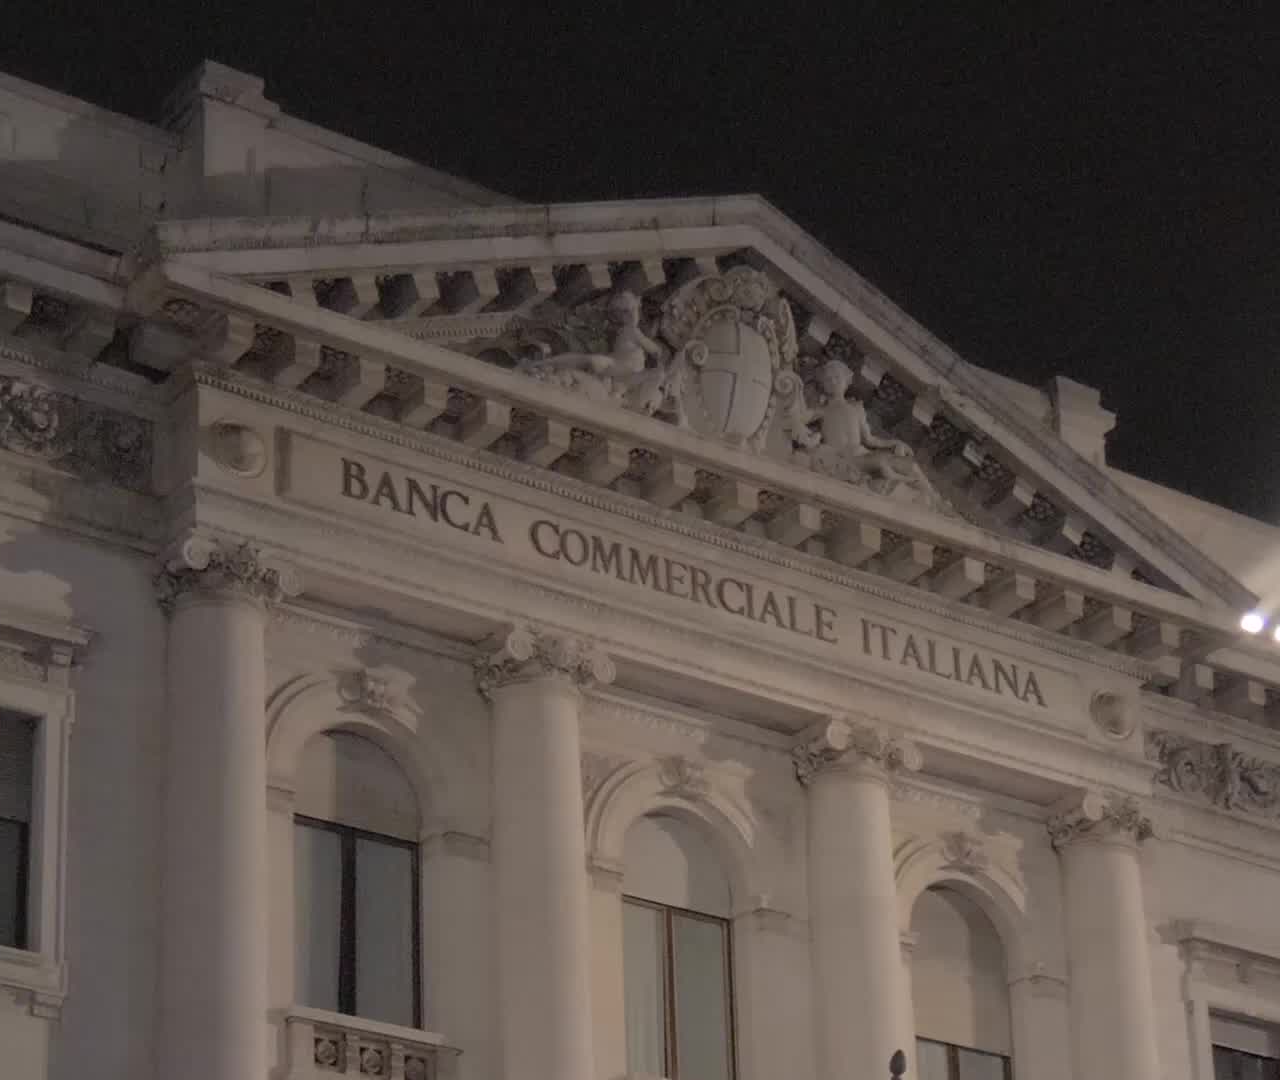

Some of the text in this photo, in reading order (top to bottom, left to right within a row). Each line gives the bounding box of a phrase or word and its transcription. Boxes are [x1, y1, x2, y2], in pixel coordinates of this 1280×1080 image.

[341, 457, 1047, 707] BANCA COMMERCIALE ITALIANA
